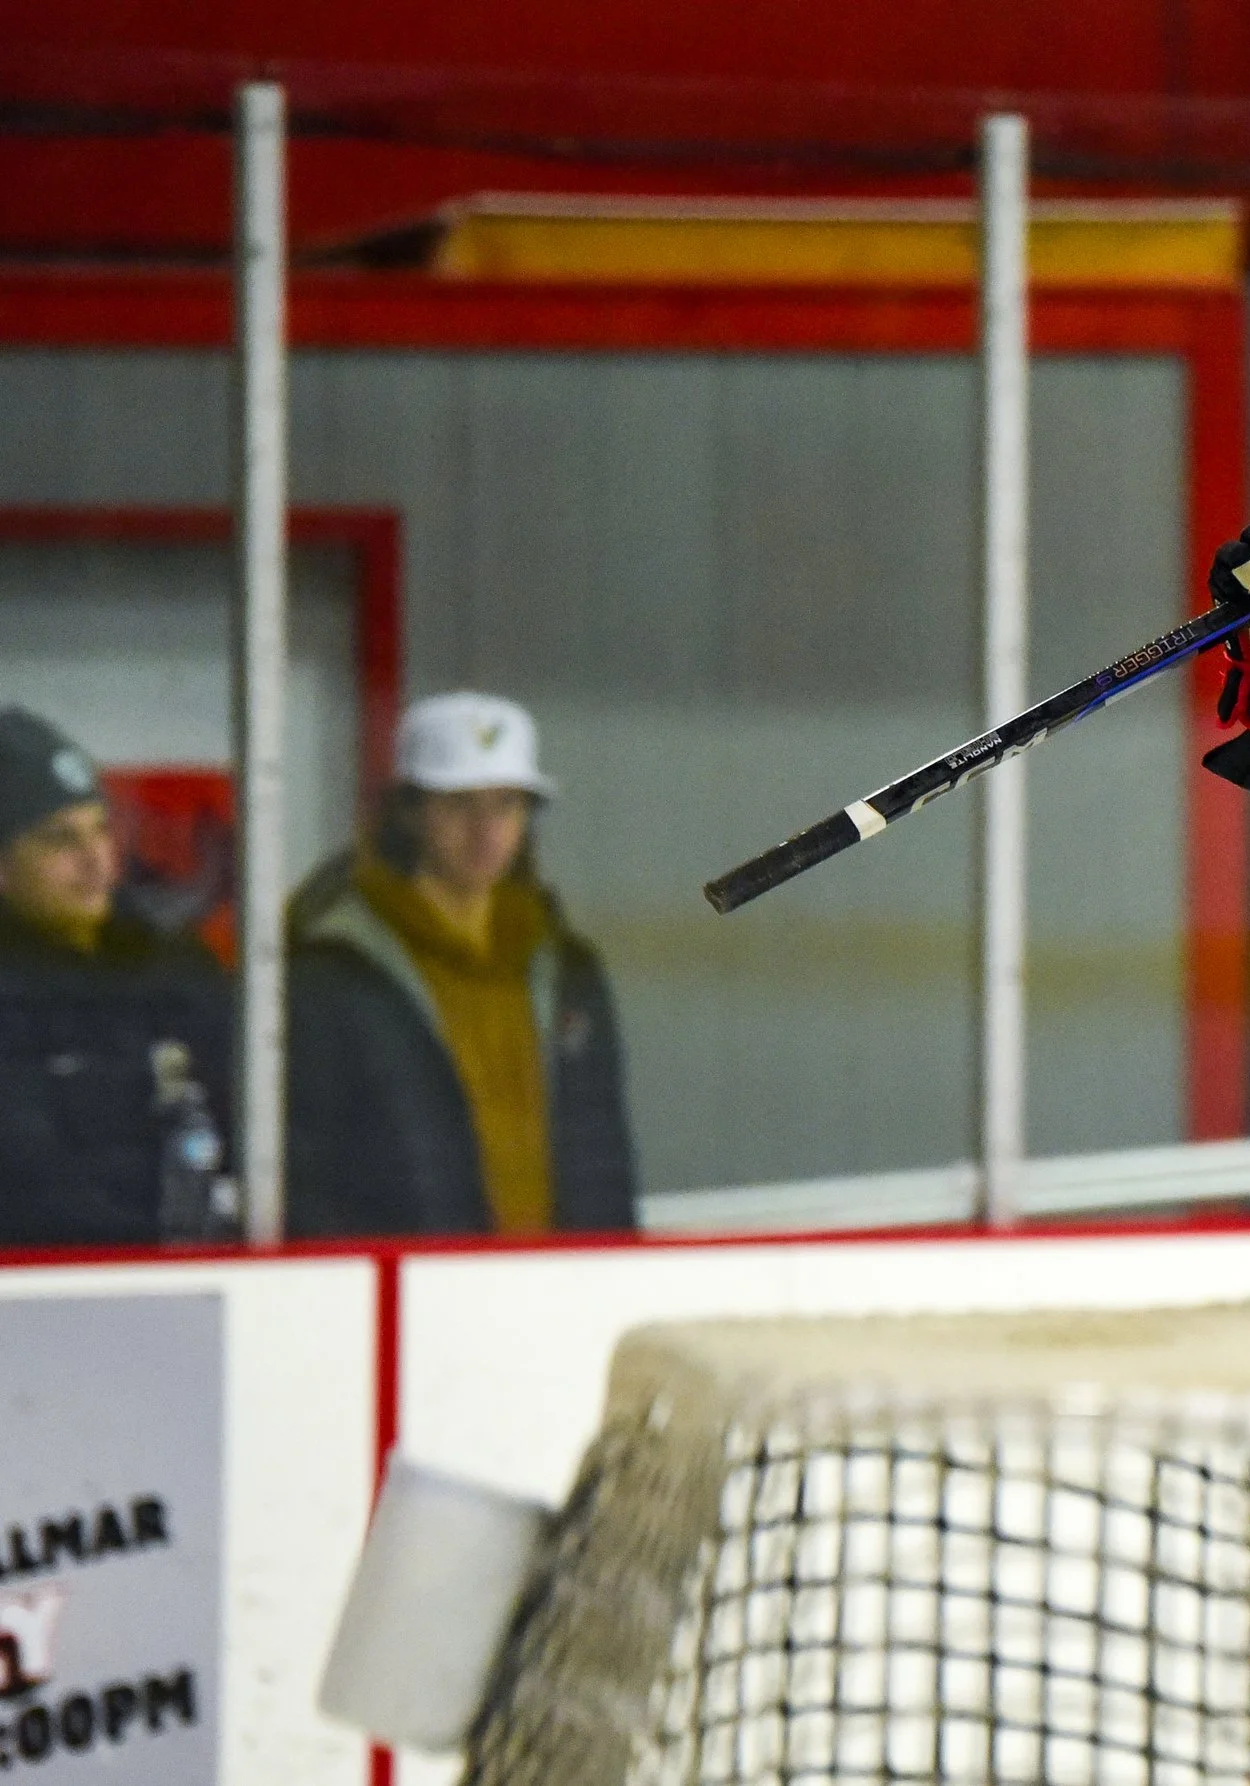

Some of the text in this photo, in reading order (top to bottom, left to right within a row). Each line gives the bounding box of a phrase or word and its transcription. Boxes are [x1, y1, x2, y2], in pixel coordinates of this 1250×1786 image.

[1113, 626, 1199, 679] TRIGGER
[950, 736, 1003, 769] NANOLITE
[0, 1494, 169, 1582] LMAR
